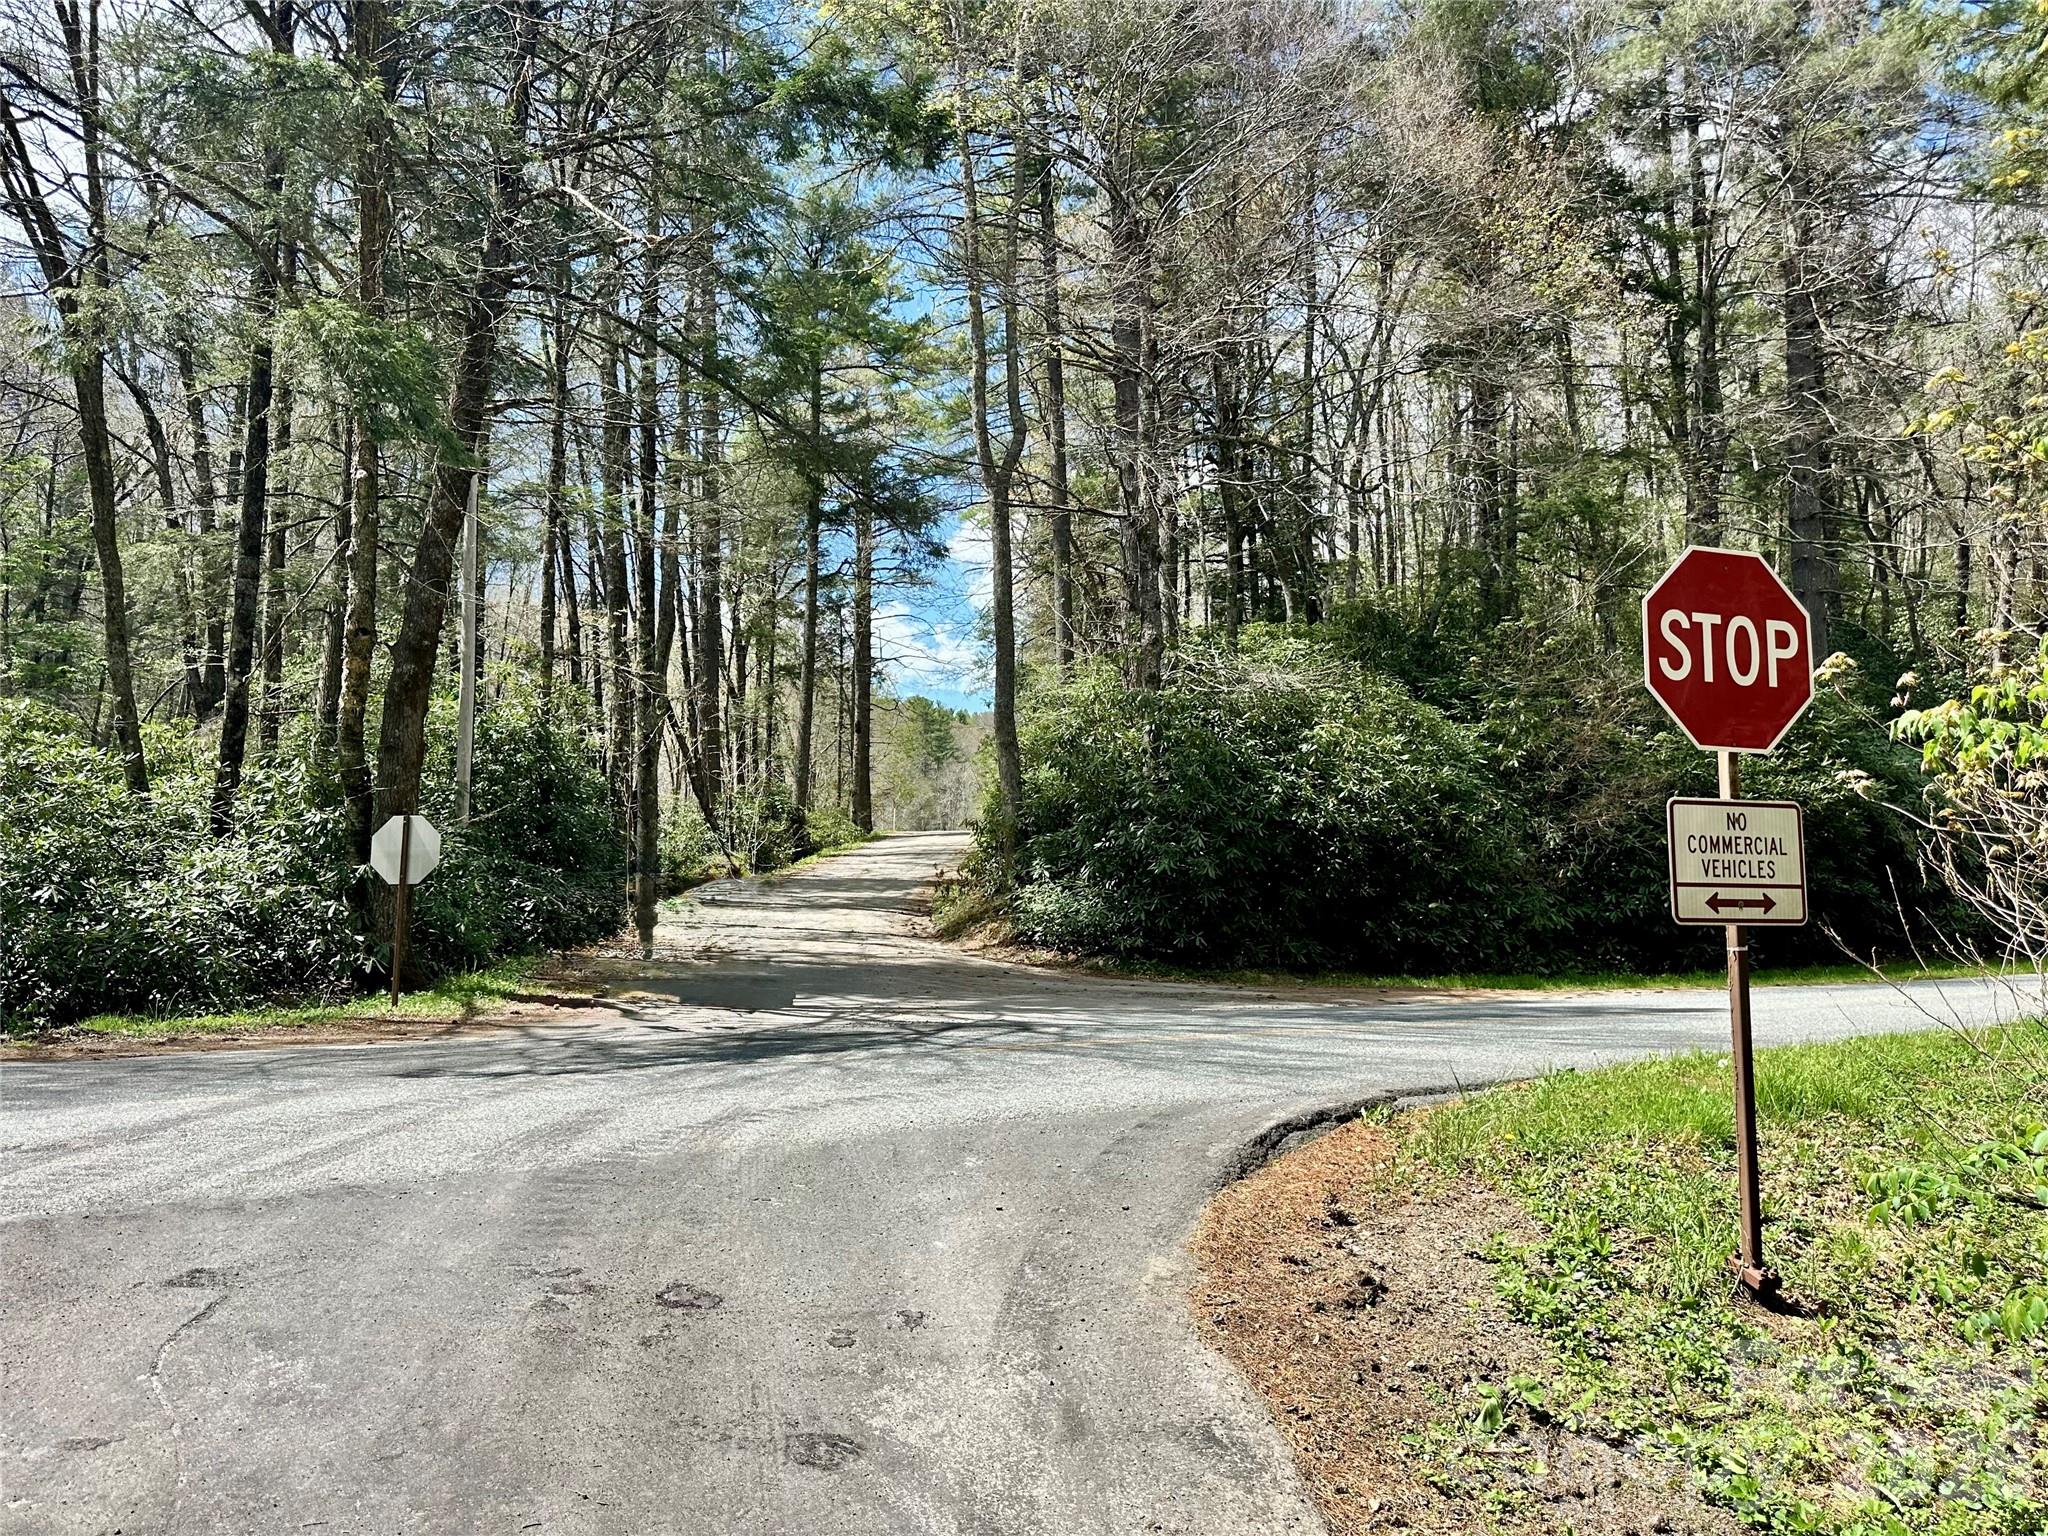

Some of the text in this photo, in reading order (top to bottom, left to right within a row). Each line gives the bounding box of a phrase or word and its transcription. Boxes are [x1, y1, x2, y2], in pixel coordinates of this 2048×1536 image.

[1659, 609, 1799, 688] STOP
[1727, 813, 1747, 831] NO
[1688, 835, 1787, 856] COMMERCIAL
[1702, 859, 1776, 879] VEHICLES
